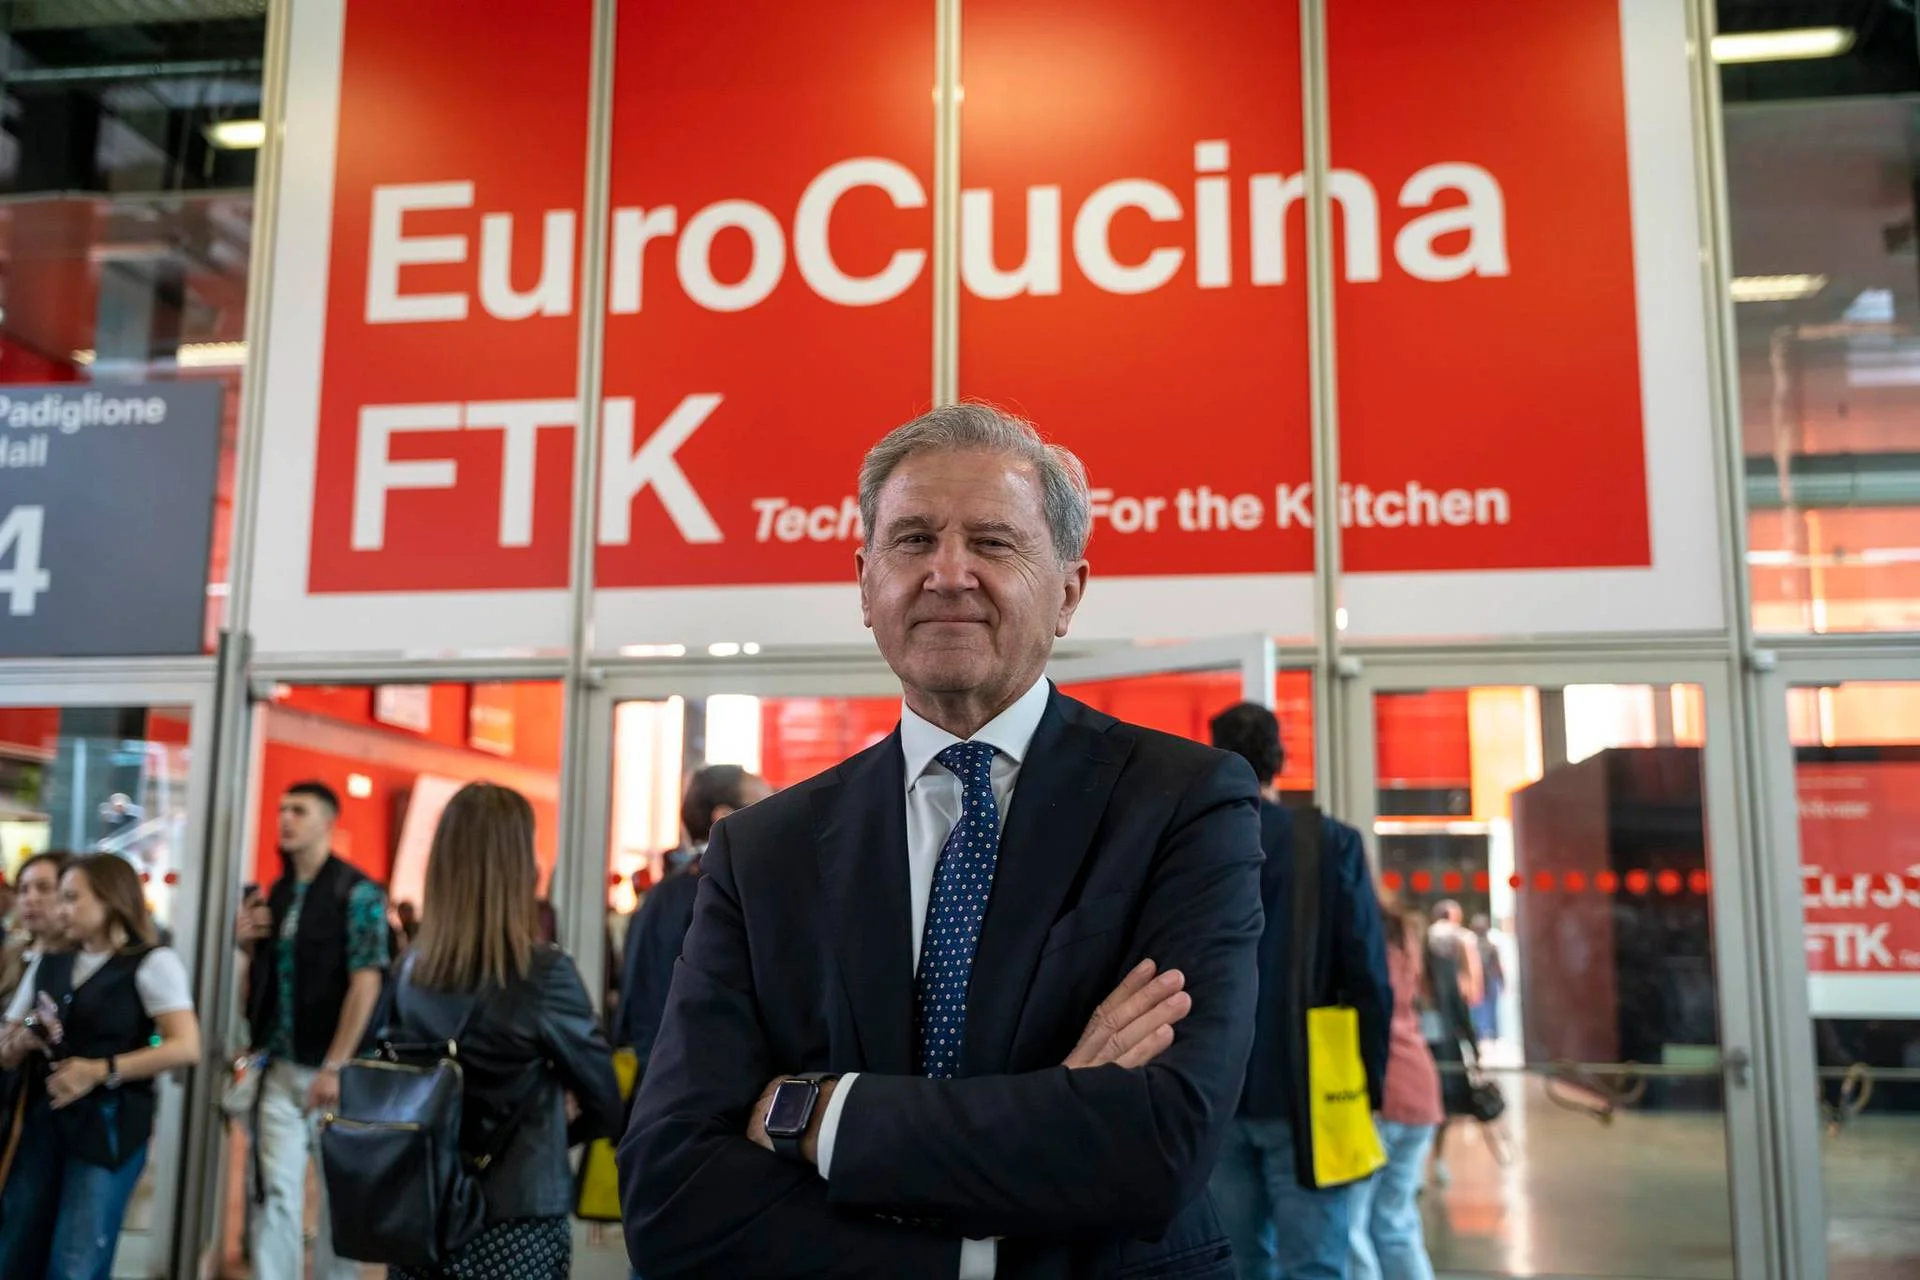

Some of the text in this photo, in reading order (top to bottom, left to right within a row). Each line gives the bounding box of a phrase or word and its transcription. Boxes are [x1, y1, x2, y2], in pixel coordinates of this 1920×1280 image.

[364, 139, 1511, 324] EuroCucina
[351, 392, 726, 551] FTK
[751, 496, 865, 543] Tech
[1174, 485, 1264, 532] the
[1275, 480, 1511, 529] Kitchen
